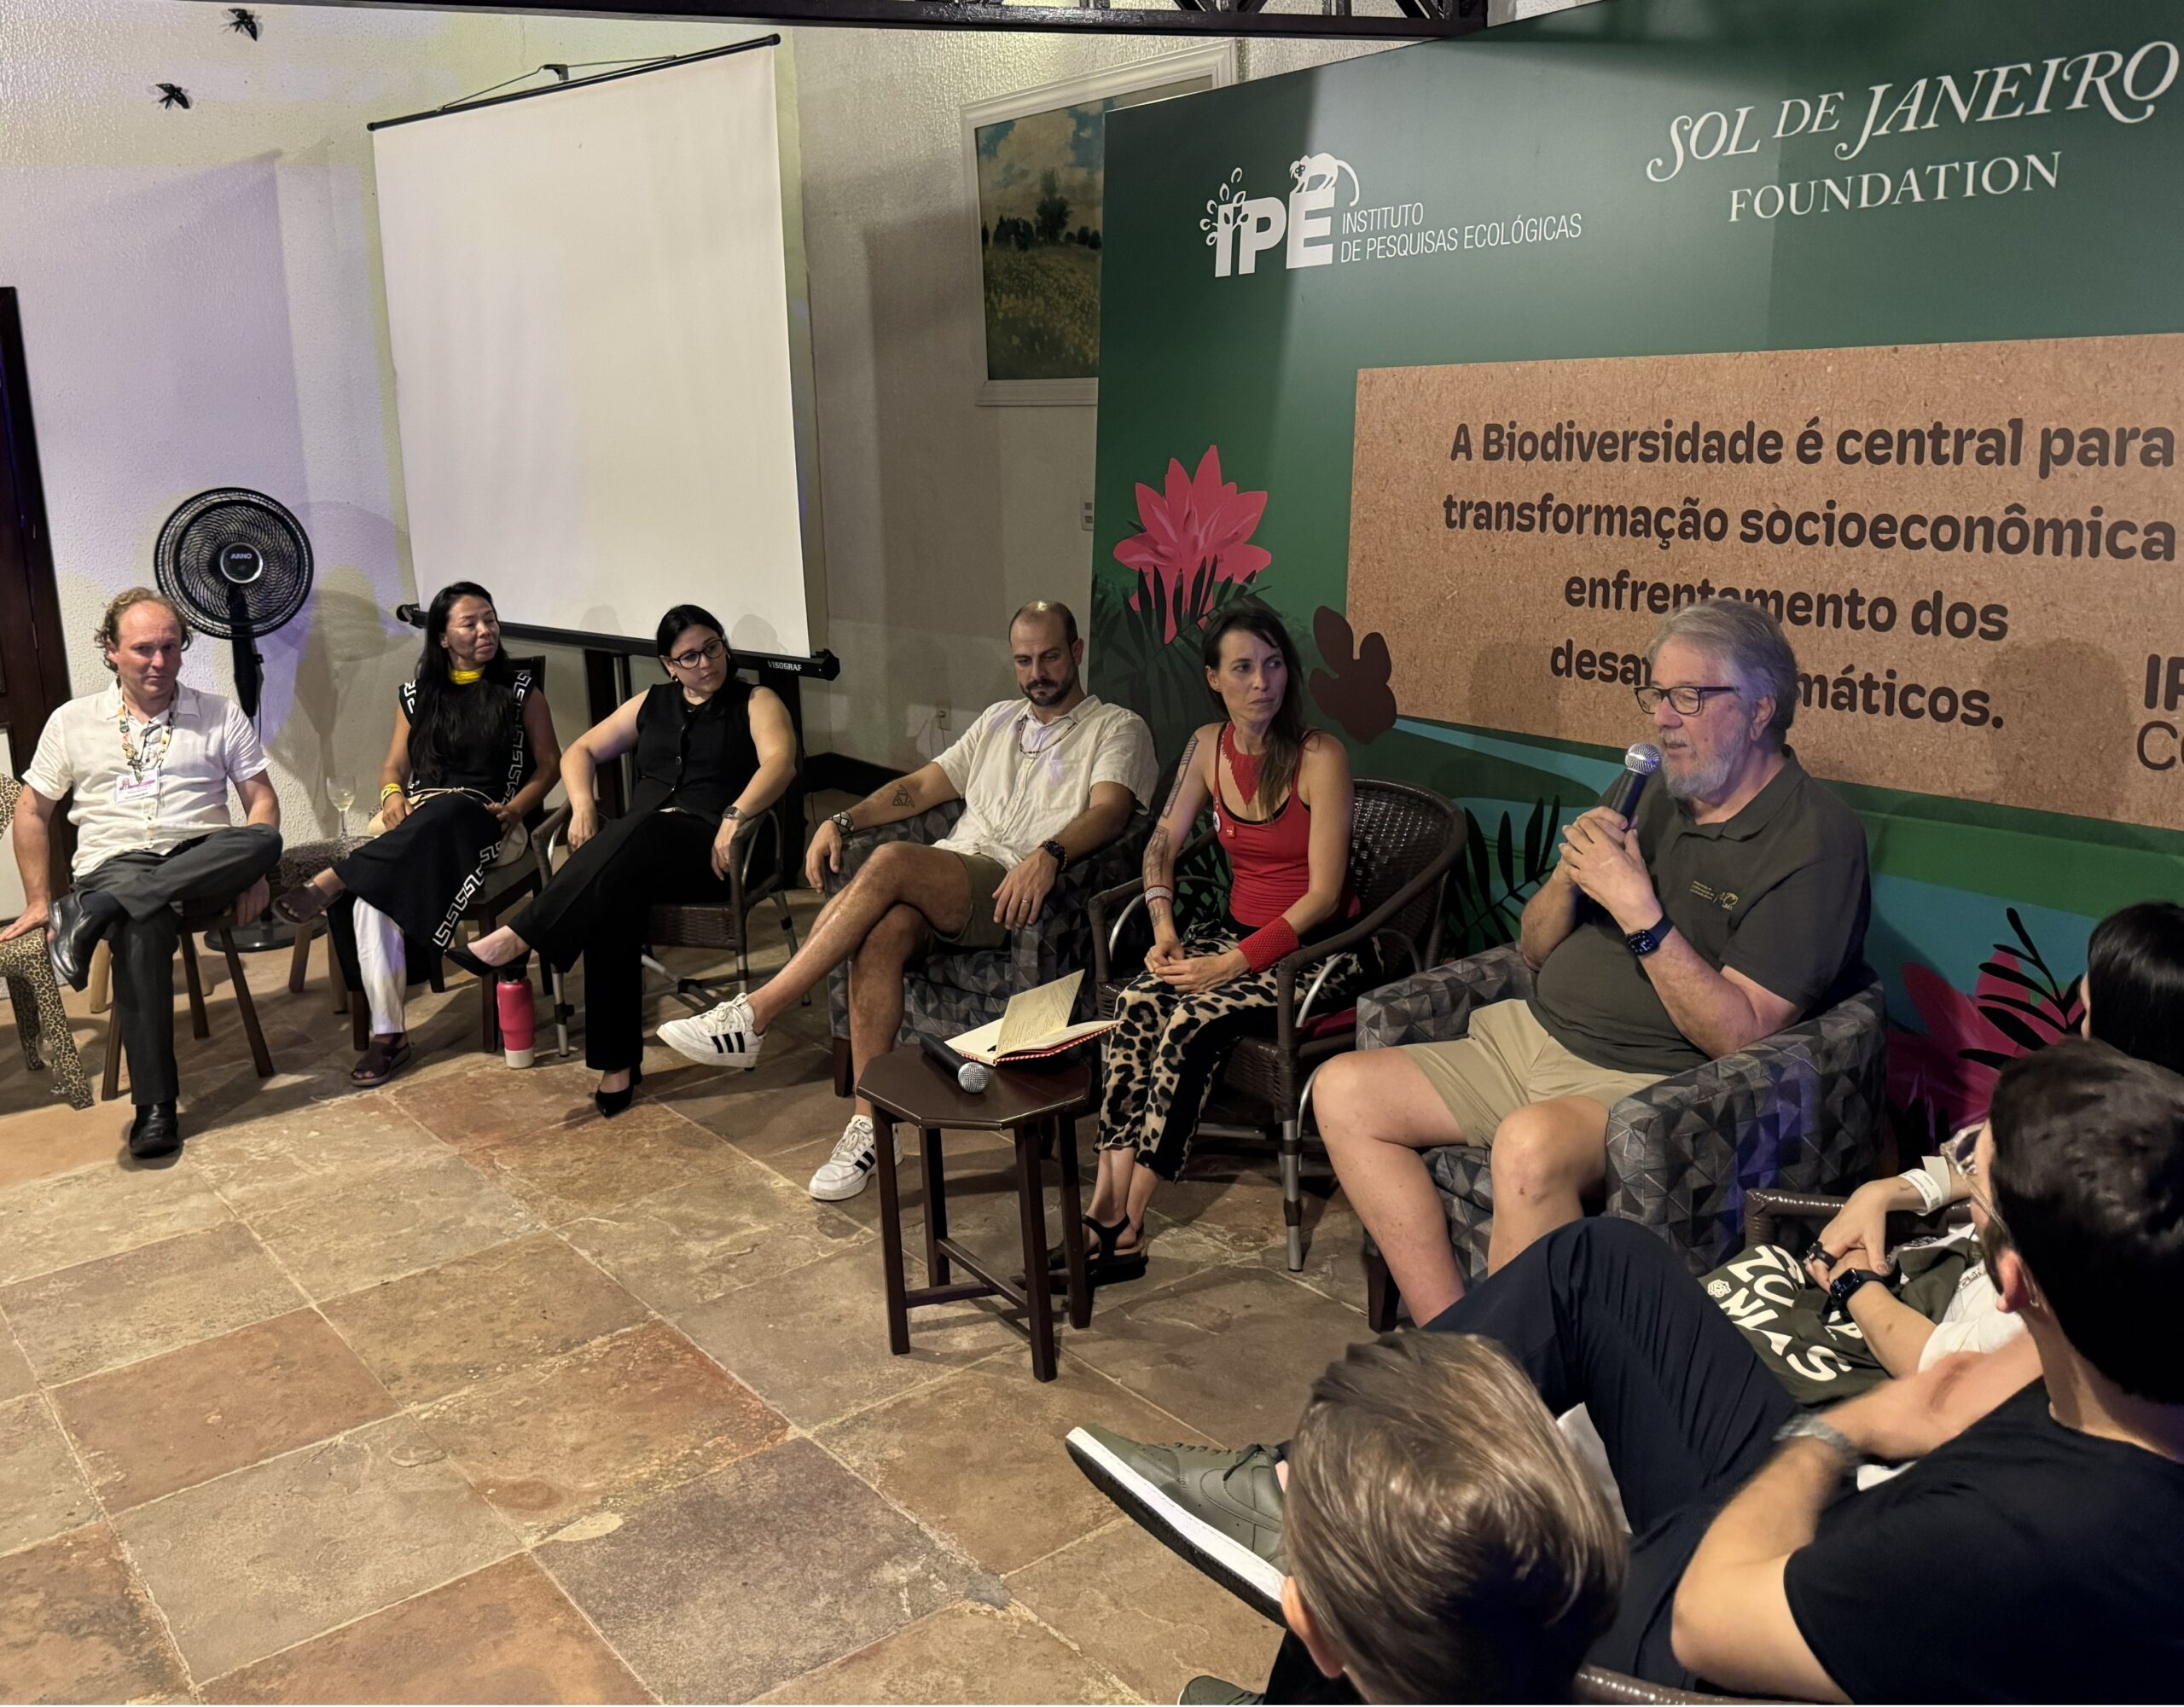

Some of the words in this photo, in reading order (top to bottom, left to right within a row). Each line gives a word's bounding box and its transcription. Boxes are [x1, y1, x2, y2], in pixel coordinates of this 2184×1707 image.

[1647, 107, 1761, 182] SOL
[1773, 91, 1844, 138] DE
[1834, 41, 2180, 160] JANEIRO
[1342, 202, 1424, 235] INSTITUTO
[1728, 151, 2062, 223] FOUNDATION
[1340, 239, 1362, 263] DE
[1366, 227, 1458, 260] PESQUISAS
[1464, 215, 1582, 249] ECOLÓGICAS
[1450, 423, 1472, 462] A
[1482, 419, 1784, 464] Biodiversidade
[1796, 415, 1823, 465] é
[1836, 417, 2024, 467] central
[2038, 426, 2175, 479] para
[1443, 492, 1728, 550] transformação
[1740, 499, 2175, 561] socioeconômica
[1911, 589, 2008, 641] dos
[1797, 664, 2004, 729] máticos.
